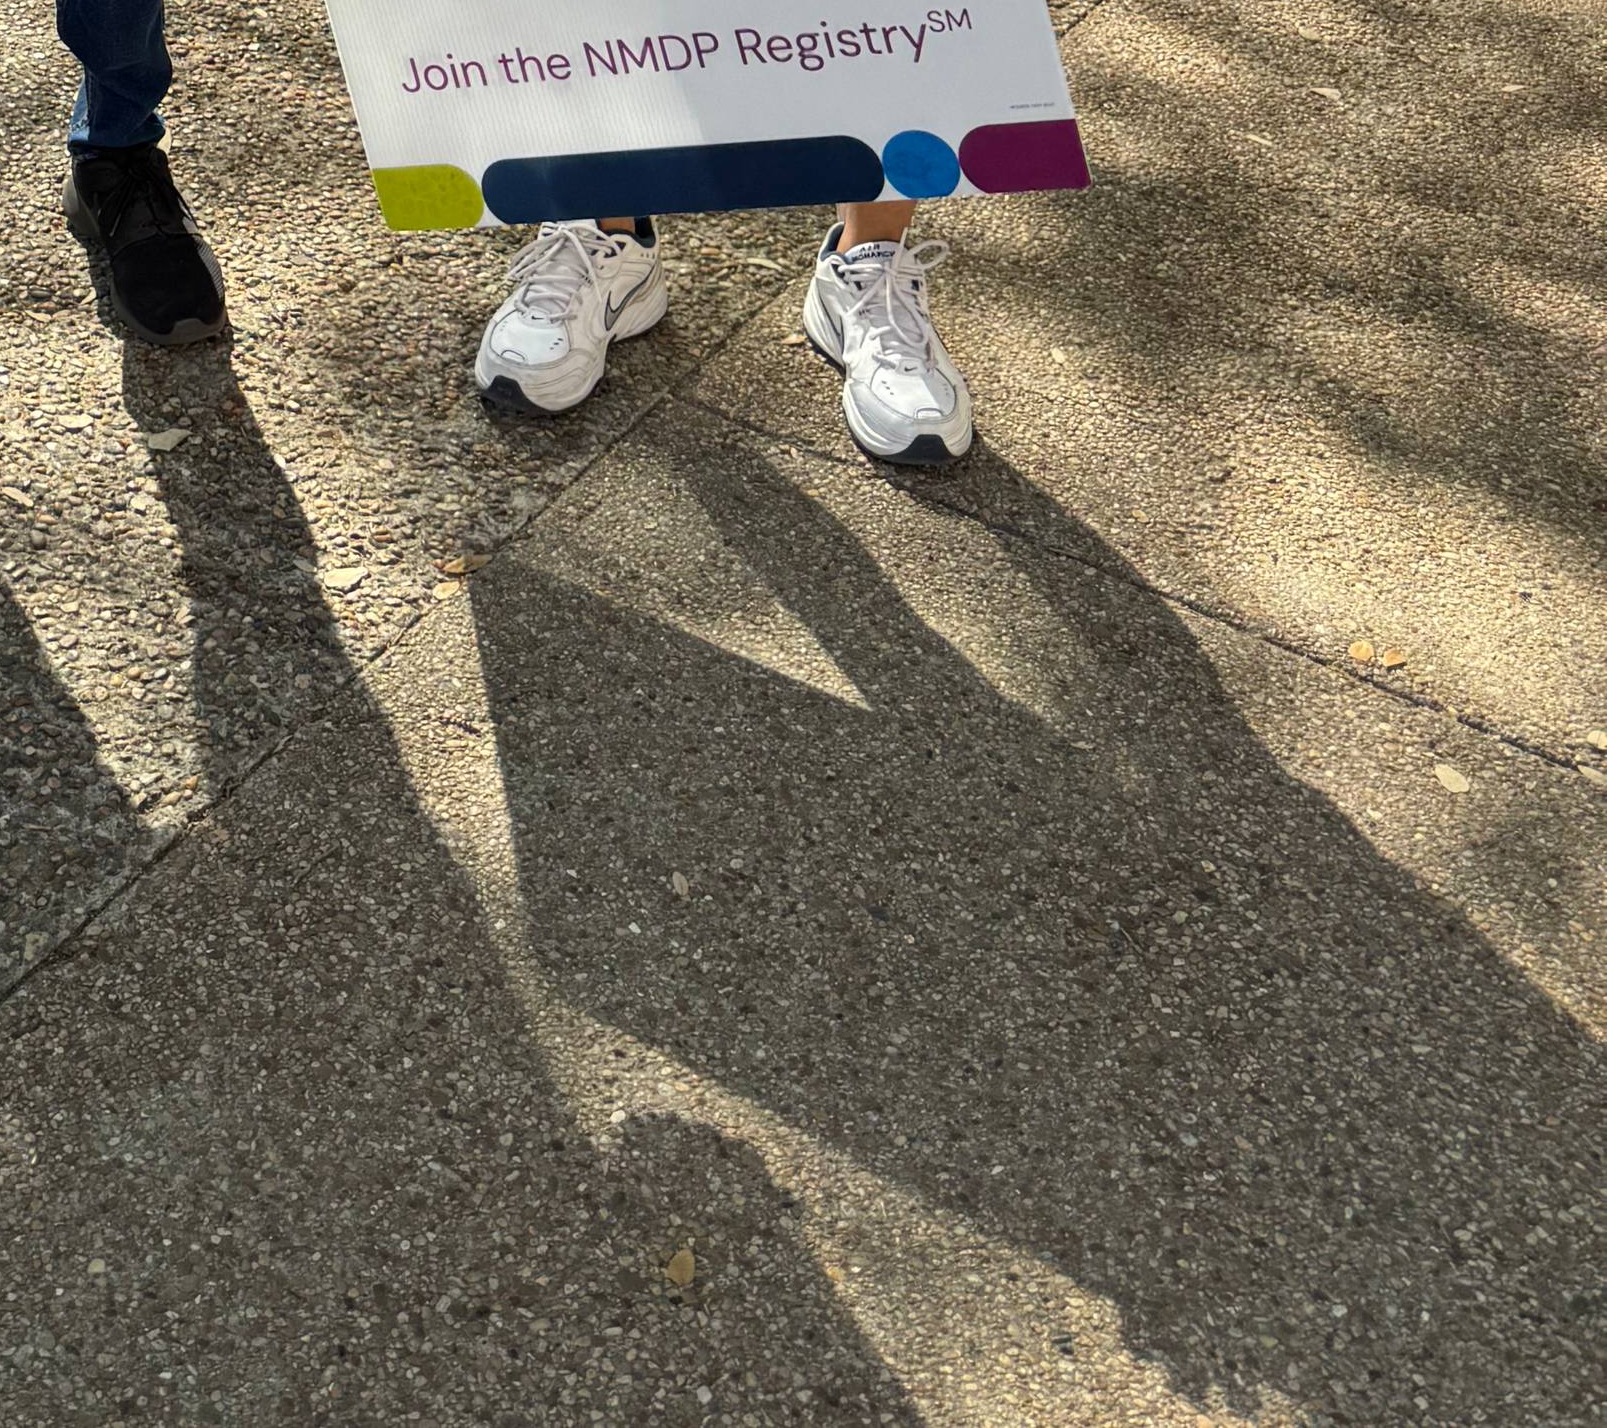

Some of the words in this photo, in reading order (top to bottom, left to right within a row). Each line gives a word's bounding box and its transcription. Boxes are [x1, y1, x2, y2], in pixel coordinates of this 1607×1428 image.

[402, 57, 487, 93] Join
[498, 47, 571, 83] the
[583, 33, 719, 76] NMDP
